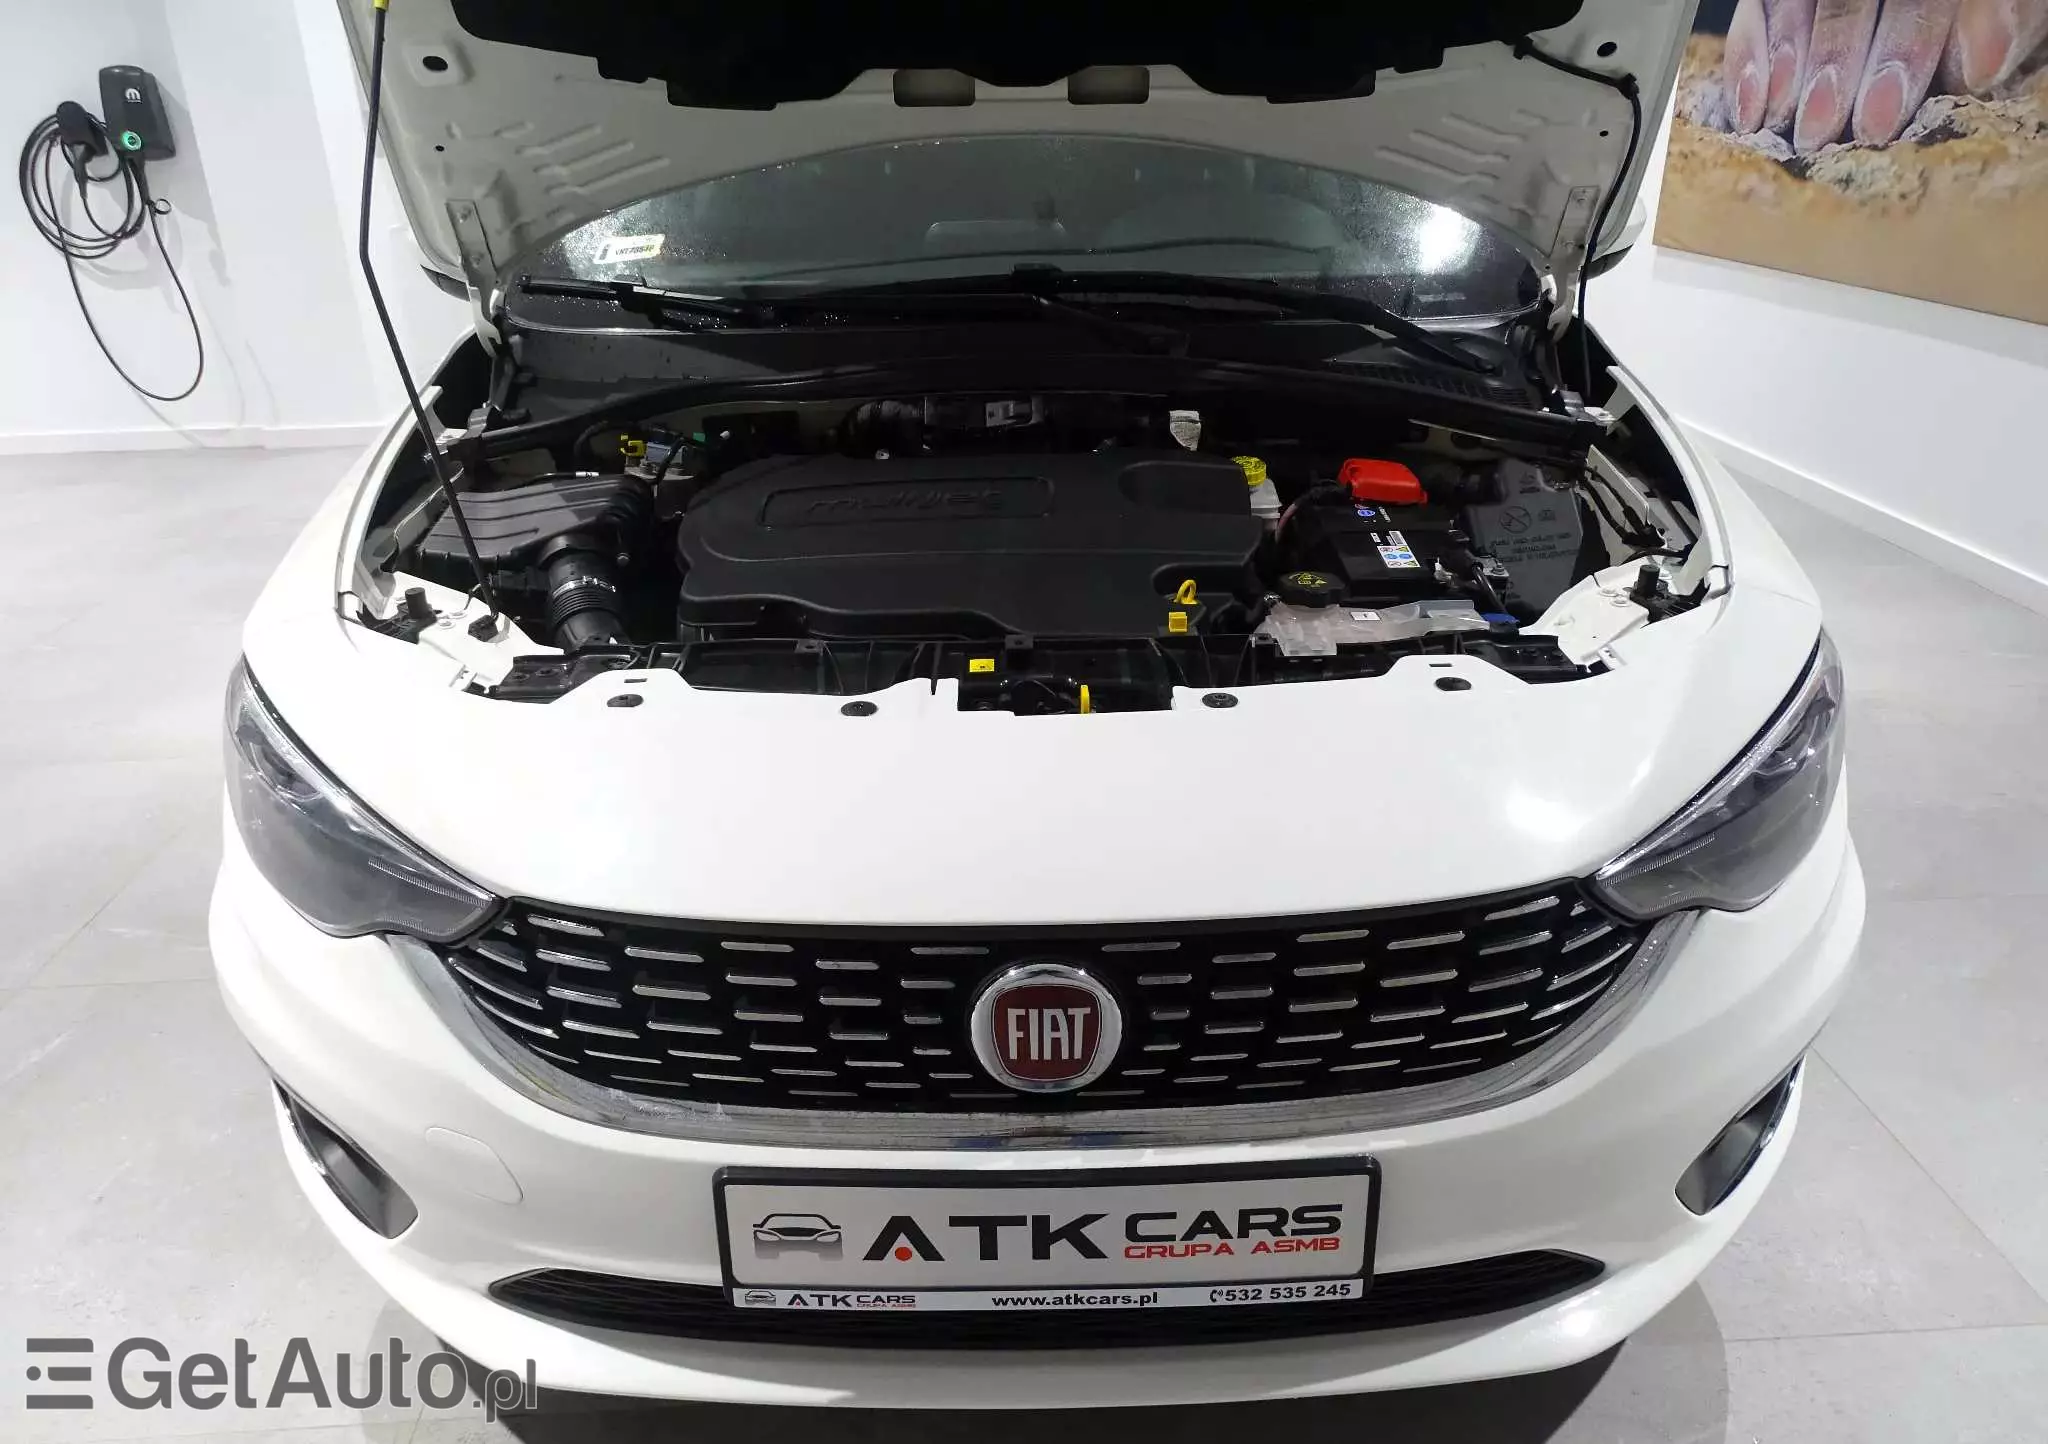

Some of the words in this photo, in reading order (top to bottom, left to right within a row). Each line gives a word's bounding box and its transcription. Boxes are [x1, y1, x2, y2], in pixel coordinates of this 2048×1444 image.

[1007, 1007, 1091, 1060] FIAT
[862, 1213, 1110, 1262] ATK
[1125, 1204, 1343, 1242] CARS
[1124, 1242, 1234, 1259] GRUPA
[1250, 1237, 1340, 1254] ASMB
[787, 1293, 852, 1307] ATK
[857, 1294, 916, 1303] CARS
[992, 1292, 1158, 1307] www.atkcars.pl
[1225, 1288, 1262, 1301] 532
[1270, 1286, 1307, 1300] 535
[1314, 1284, 1351, 1297] 245
